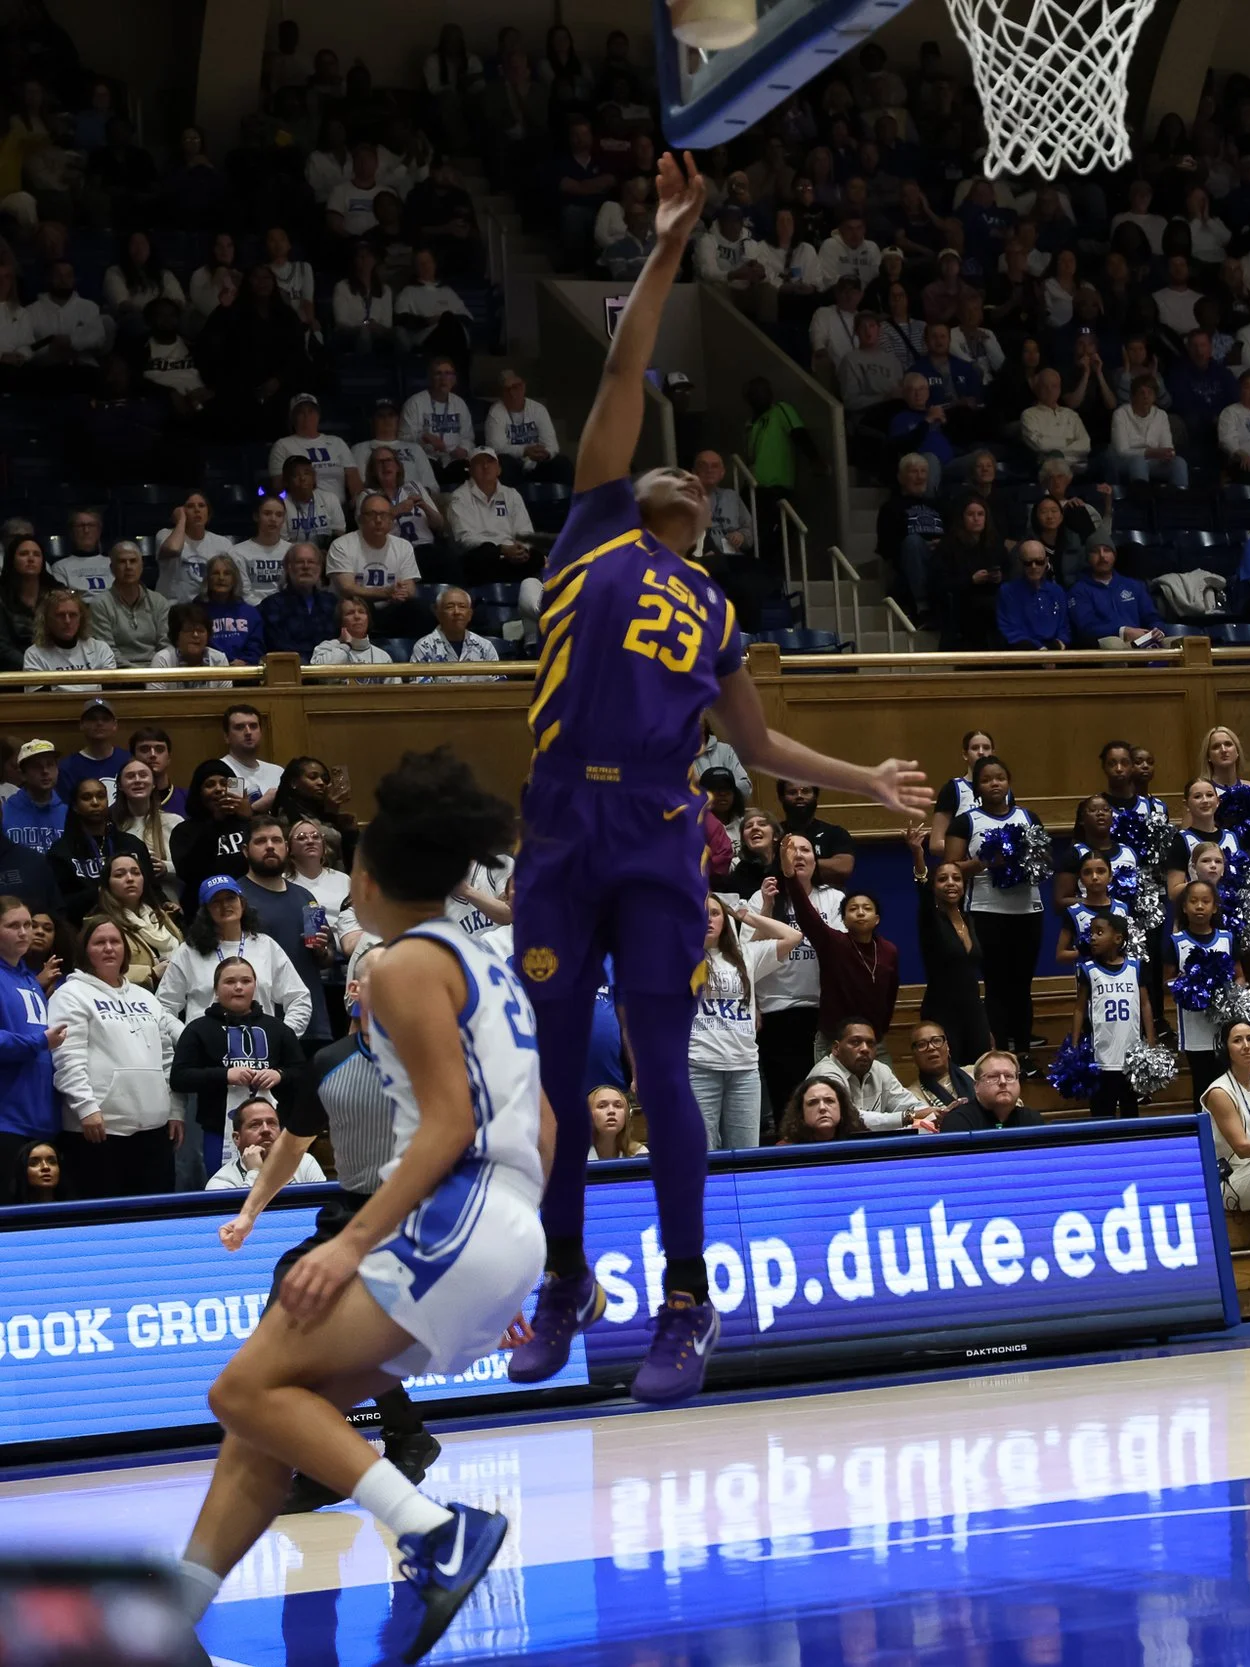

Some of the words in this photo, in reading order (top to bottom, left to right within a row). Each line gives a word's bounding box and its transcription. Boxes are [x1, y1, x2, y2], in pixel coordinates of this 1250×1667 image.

[86, 577, 107, 591] D
[368, 570, 386, 586] D
[623, 594, 703, 672] 23
[460, 911, 494, 934] UKE
[1097, 983, 1134, 995] DUKE
[94, 999, 151, 1016] DUKE
[699, 999, 753, 1021] UKE
[1104, 999, 1130, 1022] 26
[221, 1025, 269, 1060] D
[0, 1308, 115, 1361] OOK
[966, 1344, 1028, 1357] DAKTRONICS
